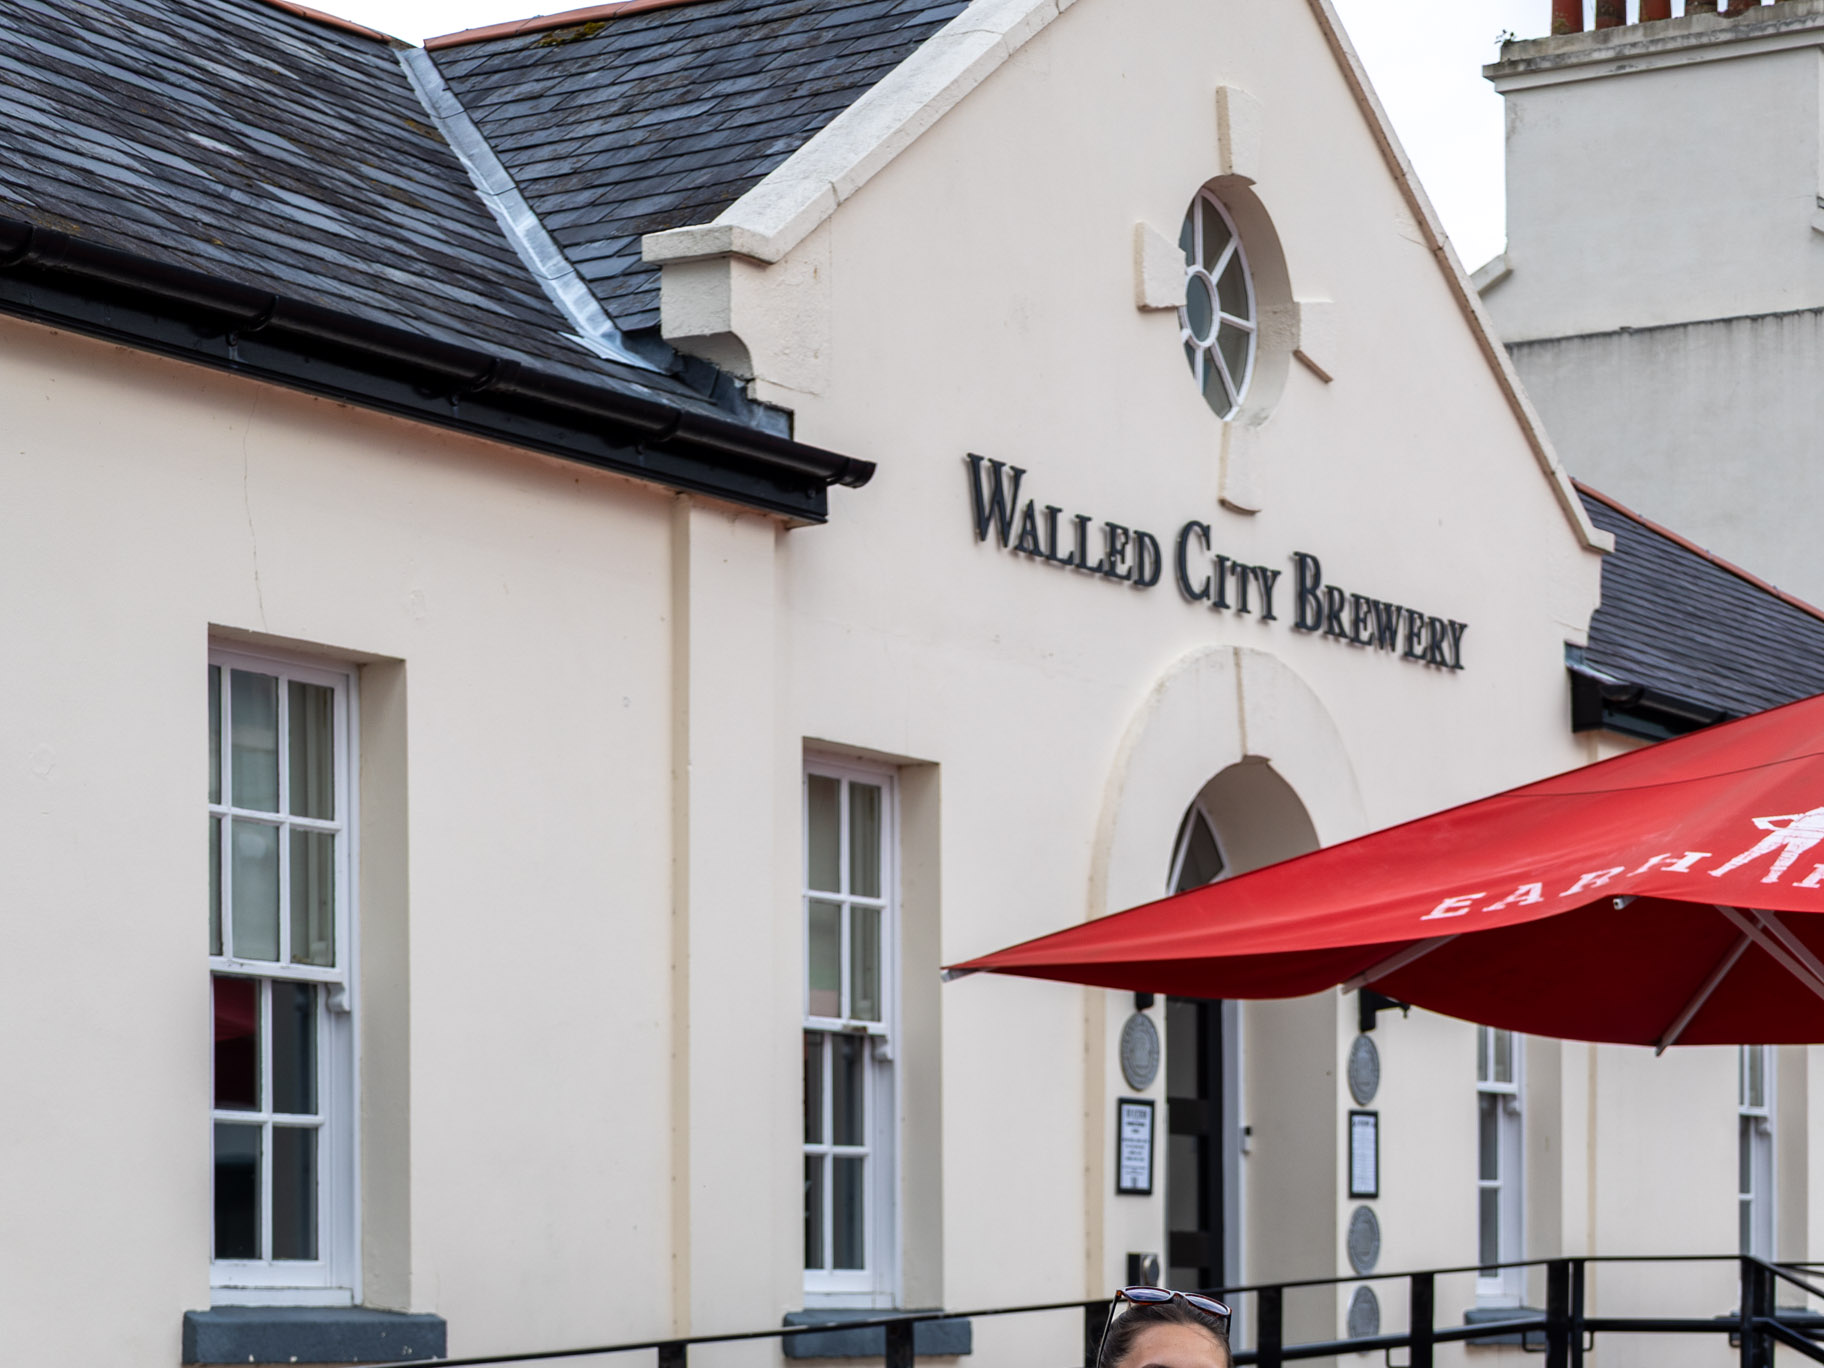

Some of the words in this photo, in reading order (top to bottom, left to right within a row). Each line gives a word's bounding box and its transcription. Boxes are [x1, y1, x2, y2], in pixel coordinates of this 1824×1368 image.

[965, 452, 1162, 588] WALLED
[1177, 520, 1281, 621] CITY
[1293, 551, 1469, 671] BREWERY
